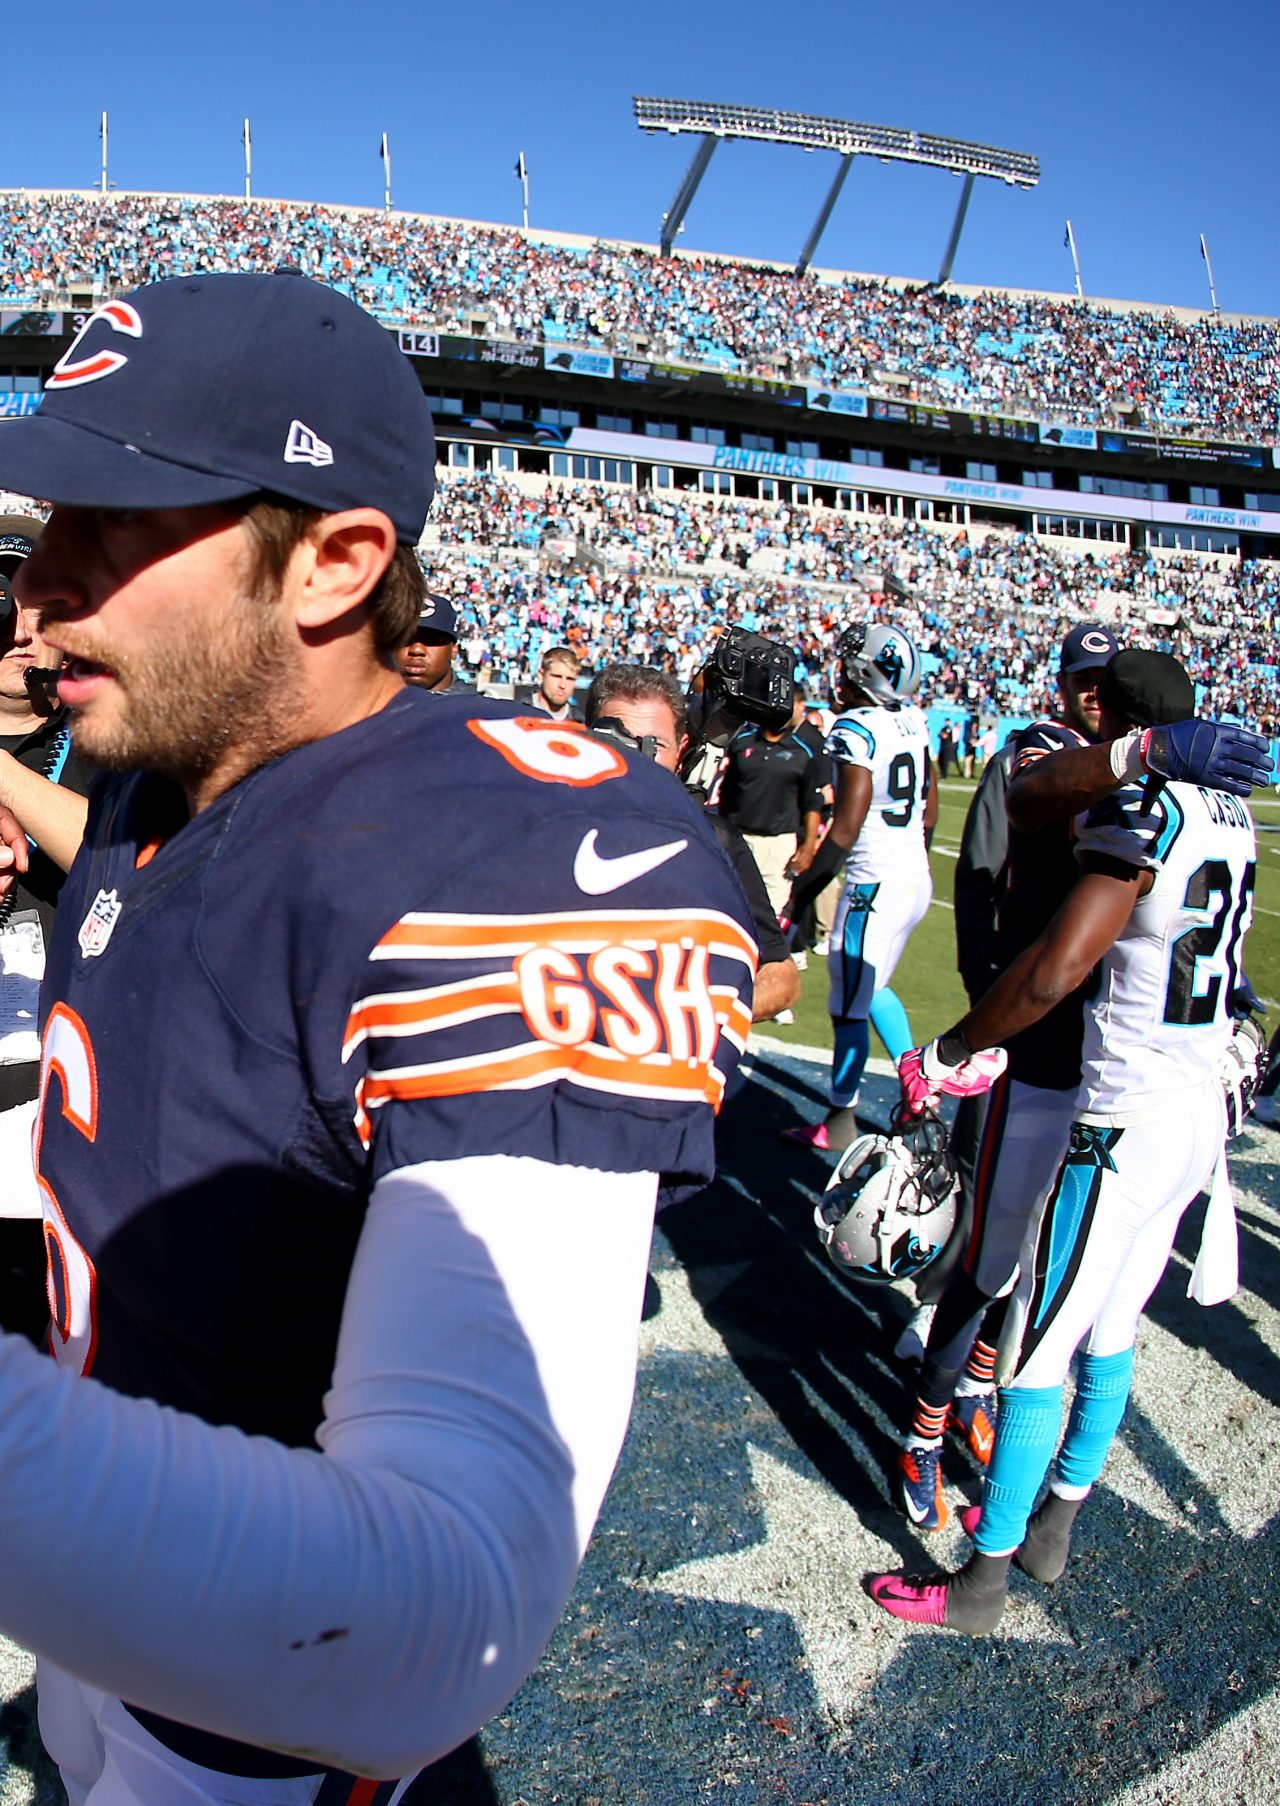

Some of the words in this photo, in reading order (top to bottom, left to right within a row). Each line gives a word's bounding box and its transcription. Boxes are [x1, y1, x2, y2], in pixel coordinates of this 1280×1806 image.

[44, 300, 143, 389] C
[406, 334, 433, 353] 14
[714, 445, 806, 477] PANTHERS
[1186, 508, 1236, 525] PANTHERS
[1081, 631, 1111, 653] C
[466, 715, 629, 787] 6
[881, 745, 930, 828] 9
[512, 943, 722, 1064] GSH
